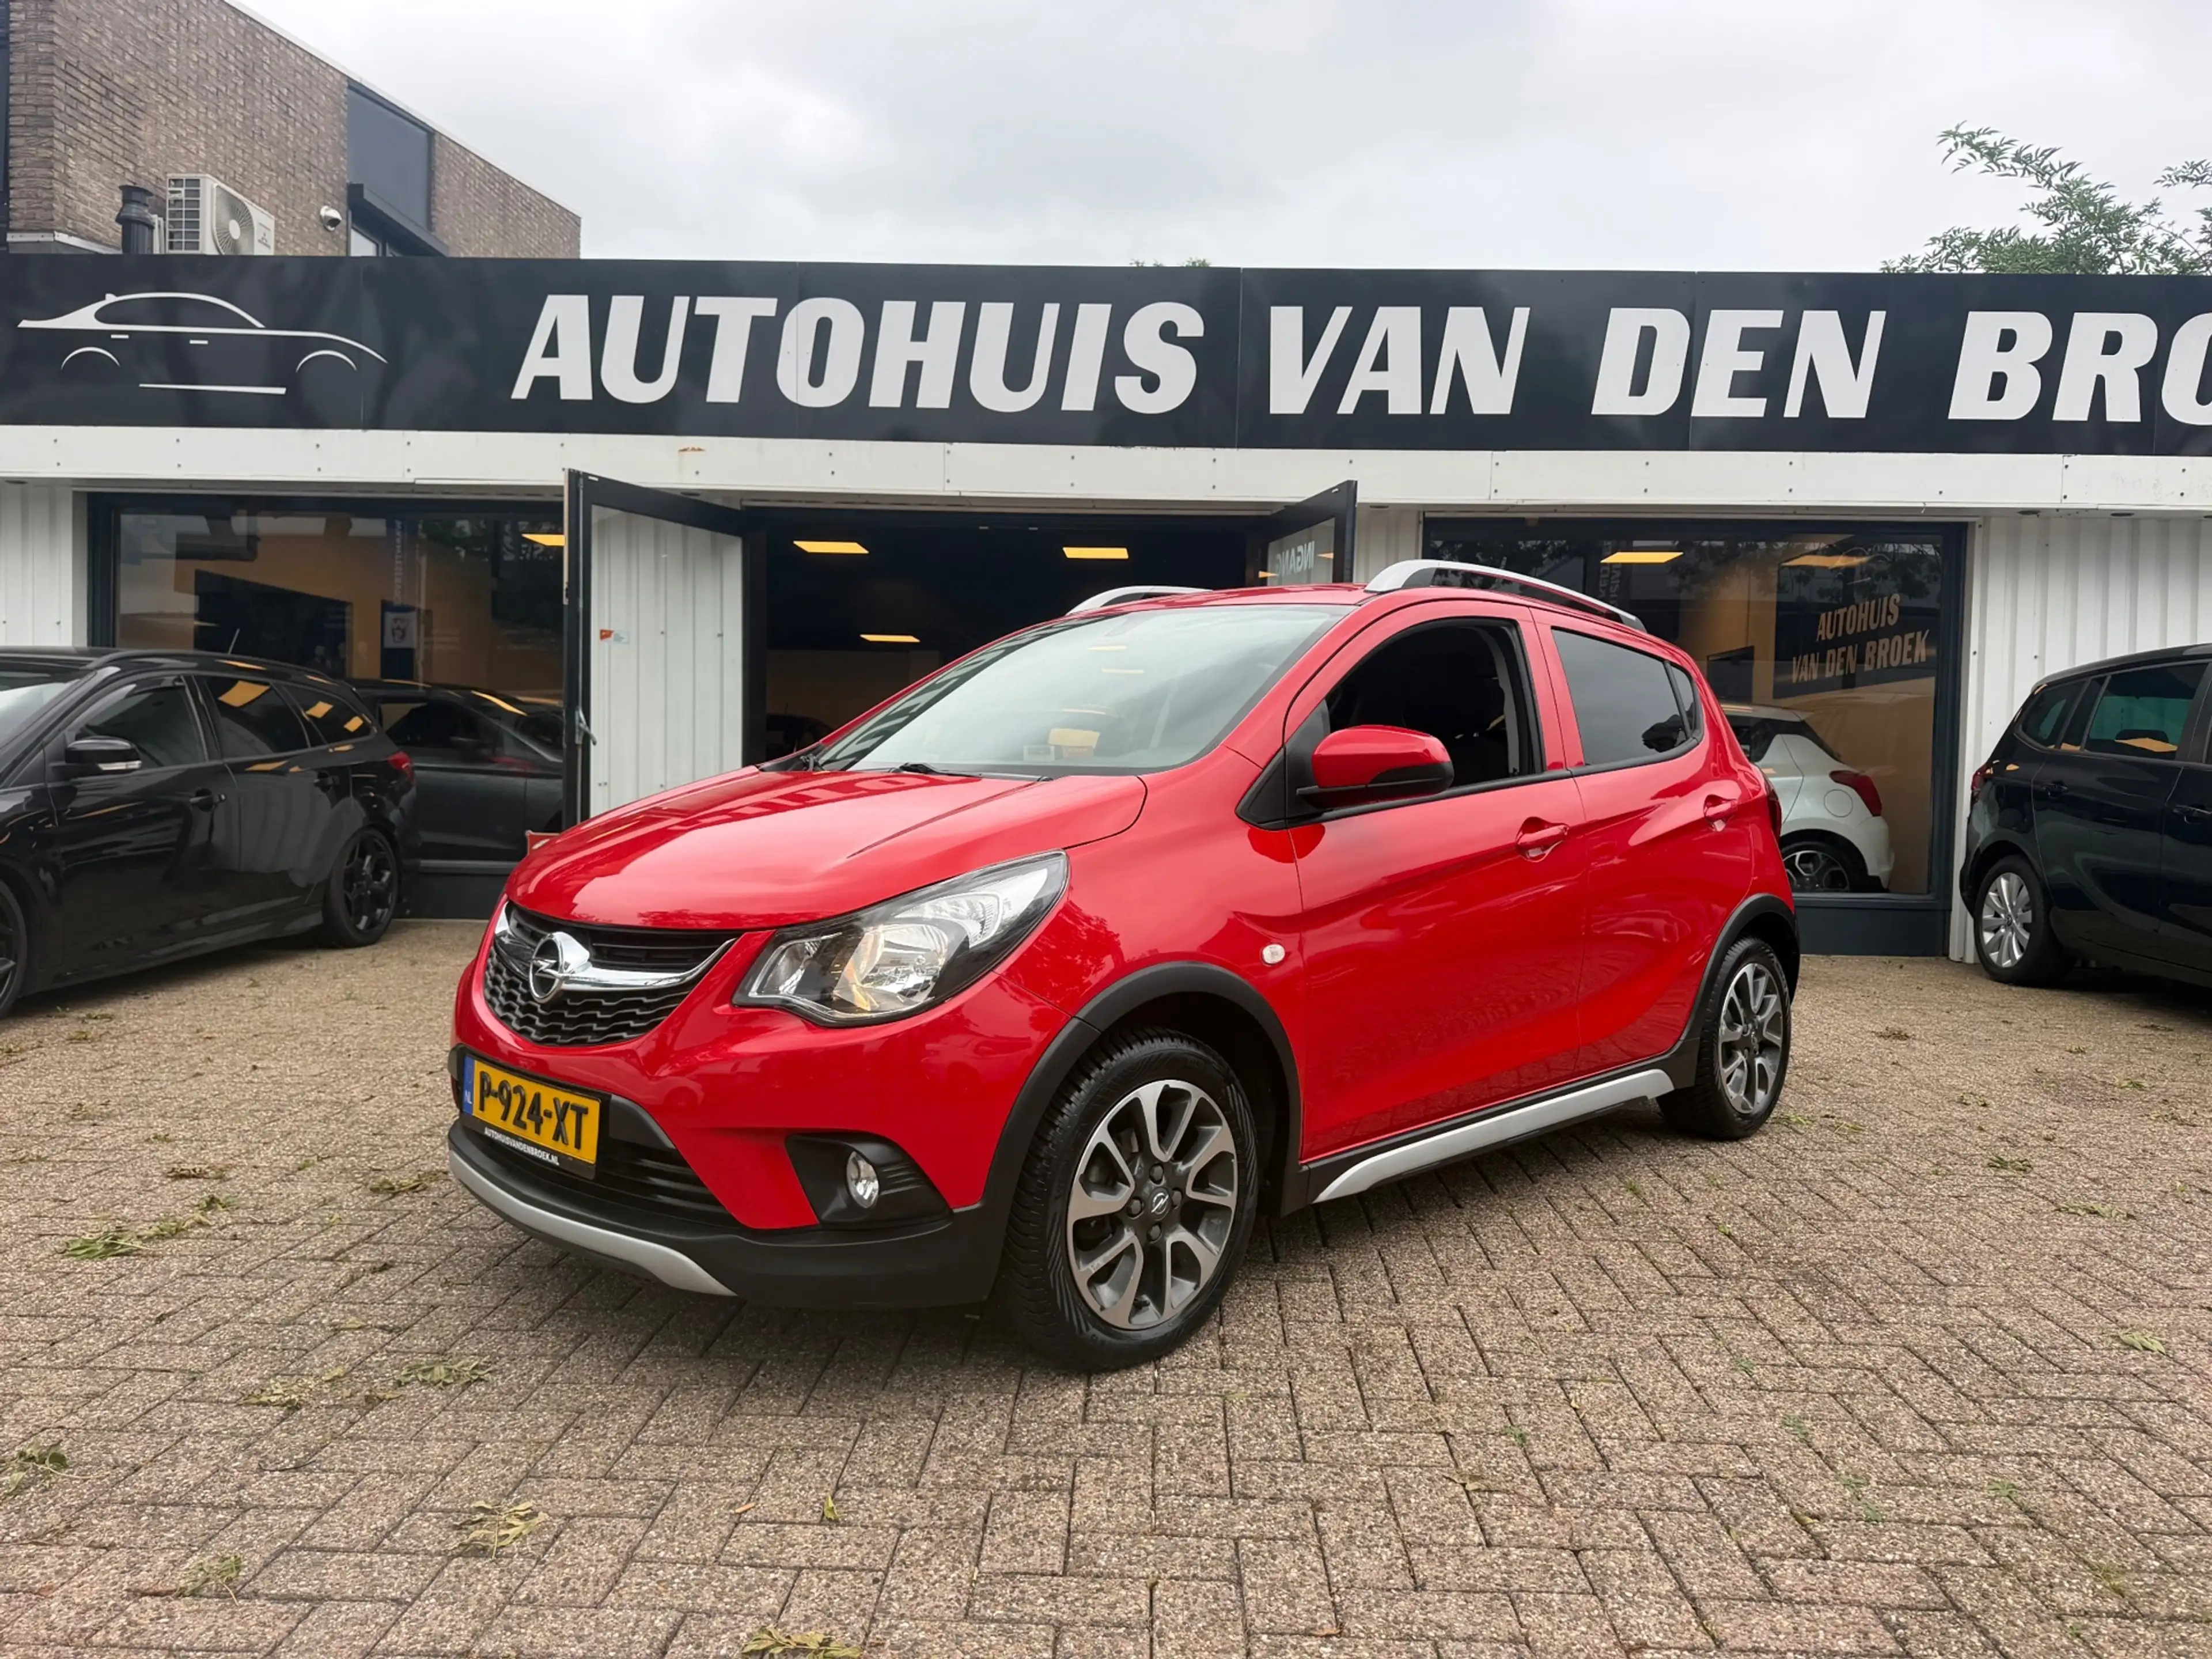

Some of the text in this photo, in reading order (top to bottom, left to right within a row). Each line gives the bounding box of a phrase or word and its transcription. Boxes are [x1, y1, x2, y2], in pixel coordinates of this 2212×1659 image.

[511, 294, 1205, 414] AUTOHUIS
[1270, 306, 1531, 415] VAN
[1591, 308, 1886, 418] DEN
[1816, 593, 1900, 641] AUTOHUIS
[1792, 629, 1930, 683] VAN DEN BROEK
[464, 1090, 472, 1104] NL
[479, 1070, 589, 1150] P-924-XT
[484, 1126, 560, 1166] AUTOHUISVANDENBROEK.NL
